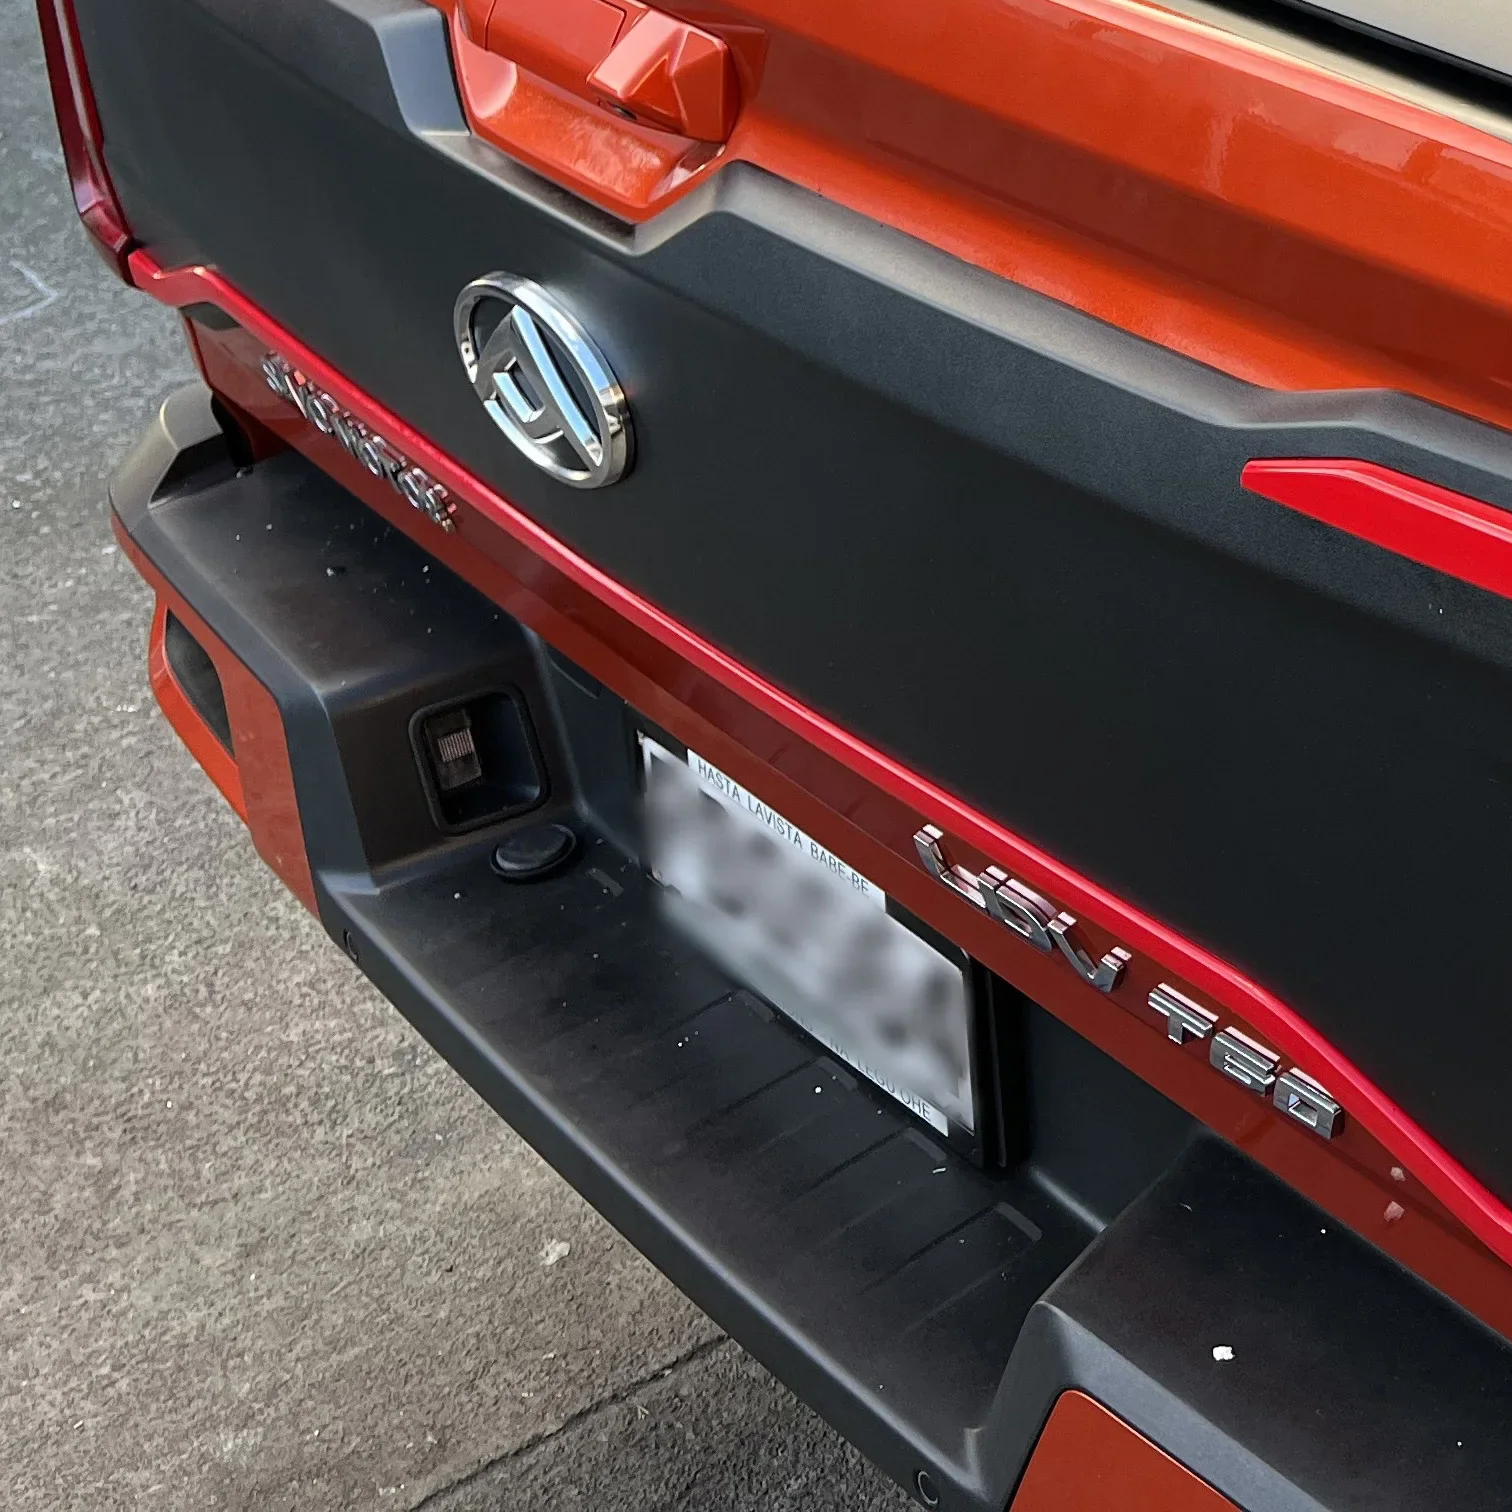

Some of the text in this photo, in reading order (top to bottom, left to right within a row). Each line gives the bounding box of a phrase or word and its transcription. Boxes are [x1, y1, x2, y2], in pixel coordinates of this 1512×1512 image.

[698, 759, 741, 802] HASTA
[747, 795, 803, 850] LAVISTA
[912, 824, 1346, 1141] LDV T60
